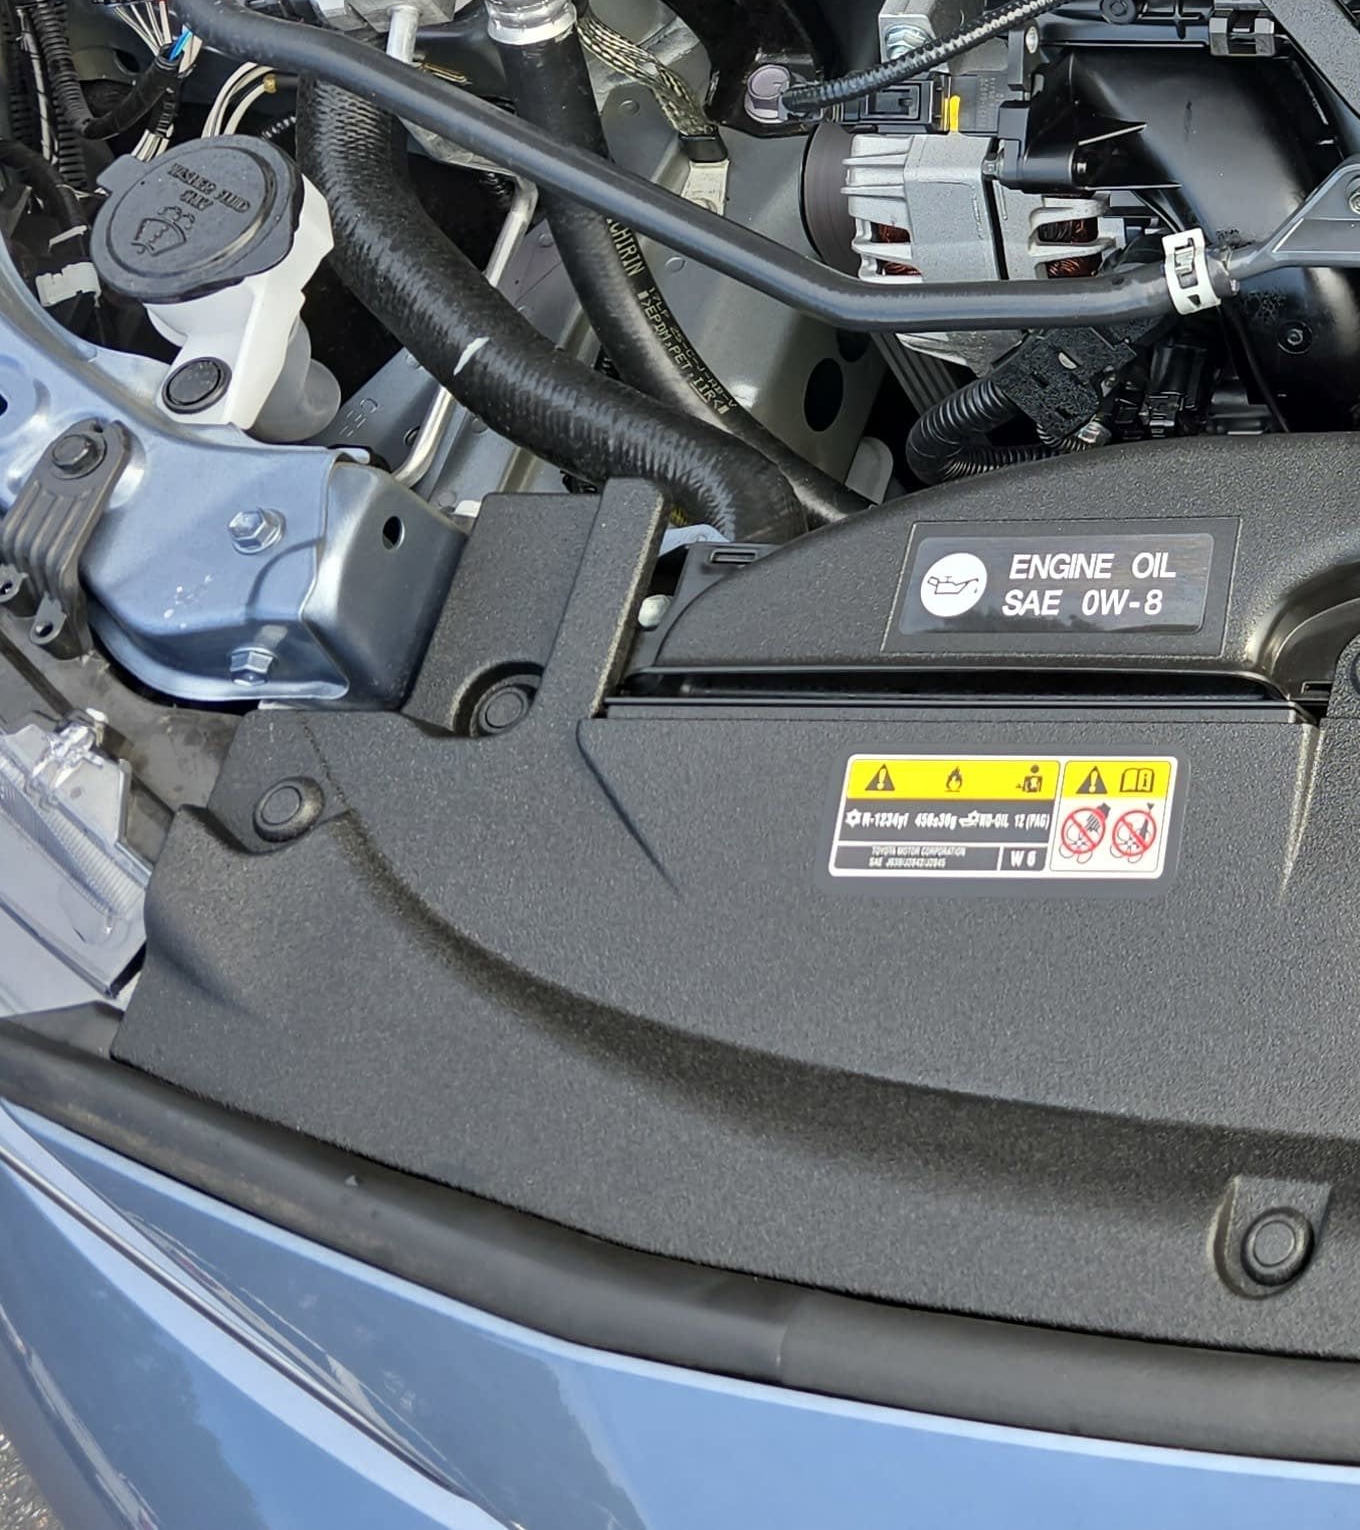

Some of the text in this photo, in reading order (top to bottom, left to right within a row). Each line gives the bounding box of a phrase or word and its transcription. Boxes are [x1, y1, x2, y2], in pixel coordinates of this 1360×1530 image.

[1008, 552, 1177, 580] ENGINE OIL
[1002, 589, 1163, 617] SAE 0W-8
[862, 812, 910, 830] R-1234yf
[1025, 813, 1050, 831] (PAG)
[1010, 850, 1023, 868] W
